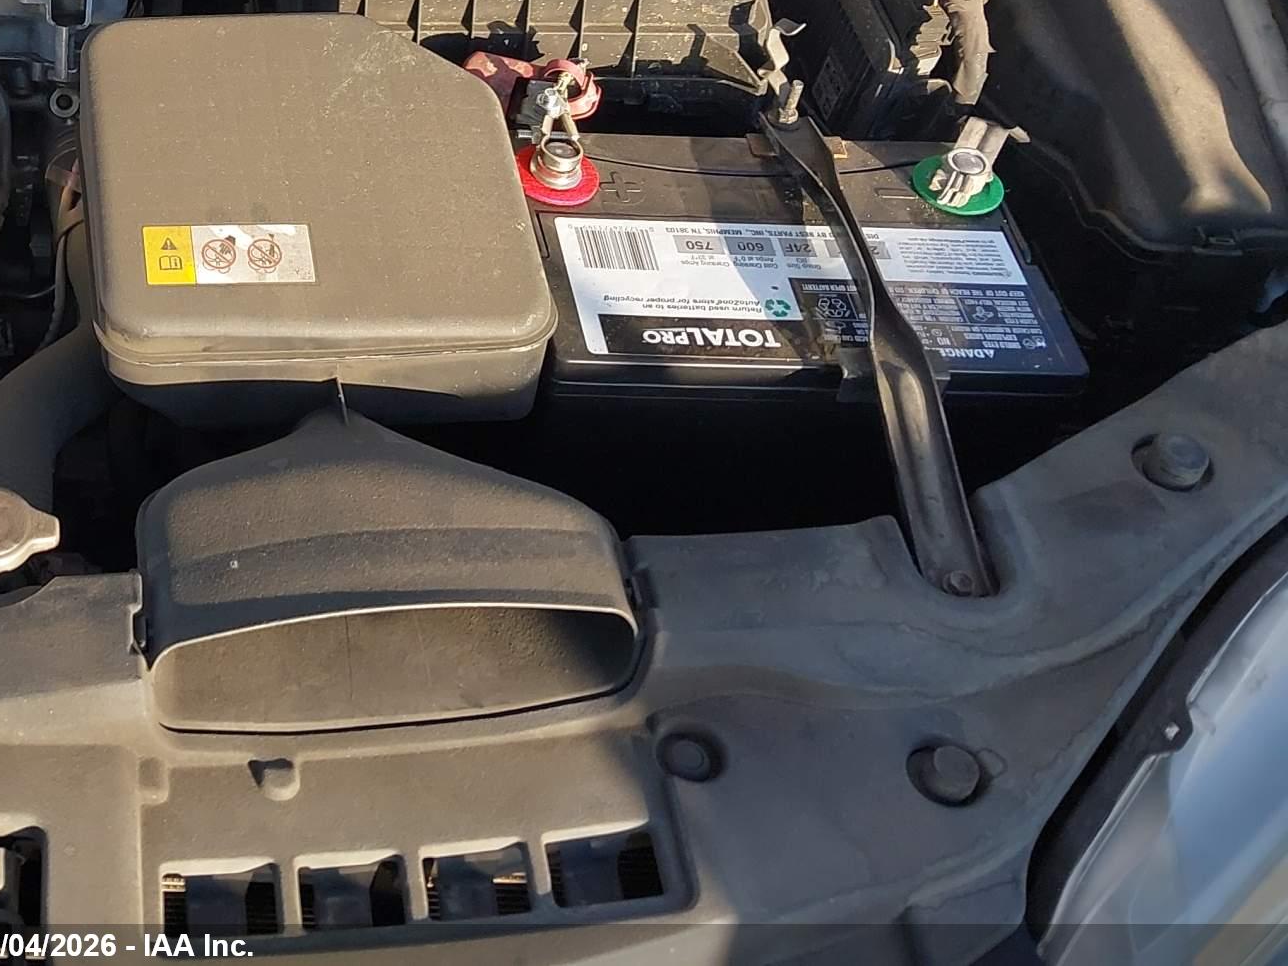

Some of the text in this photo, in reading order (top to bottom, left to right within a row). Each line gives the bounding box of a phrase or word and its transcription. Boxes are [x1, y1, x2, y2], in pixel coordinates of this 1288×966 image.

[685, 241, 714, 251] 750
[737, 242, 764, 252] 600
[785, 243, 811, 253] 24F
[733, 260, 762, 269] Cranking
[641, 327, 781, 347] TOTALPRO
[936, 337, 951, 346] NO
